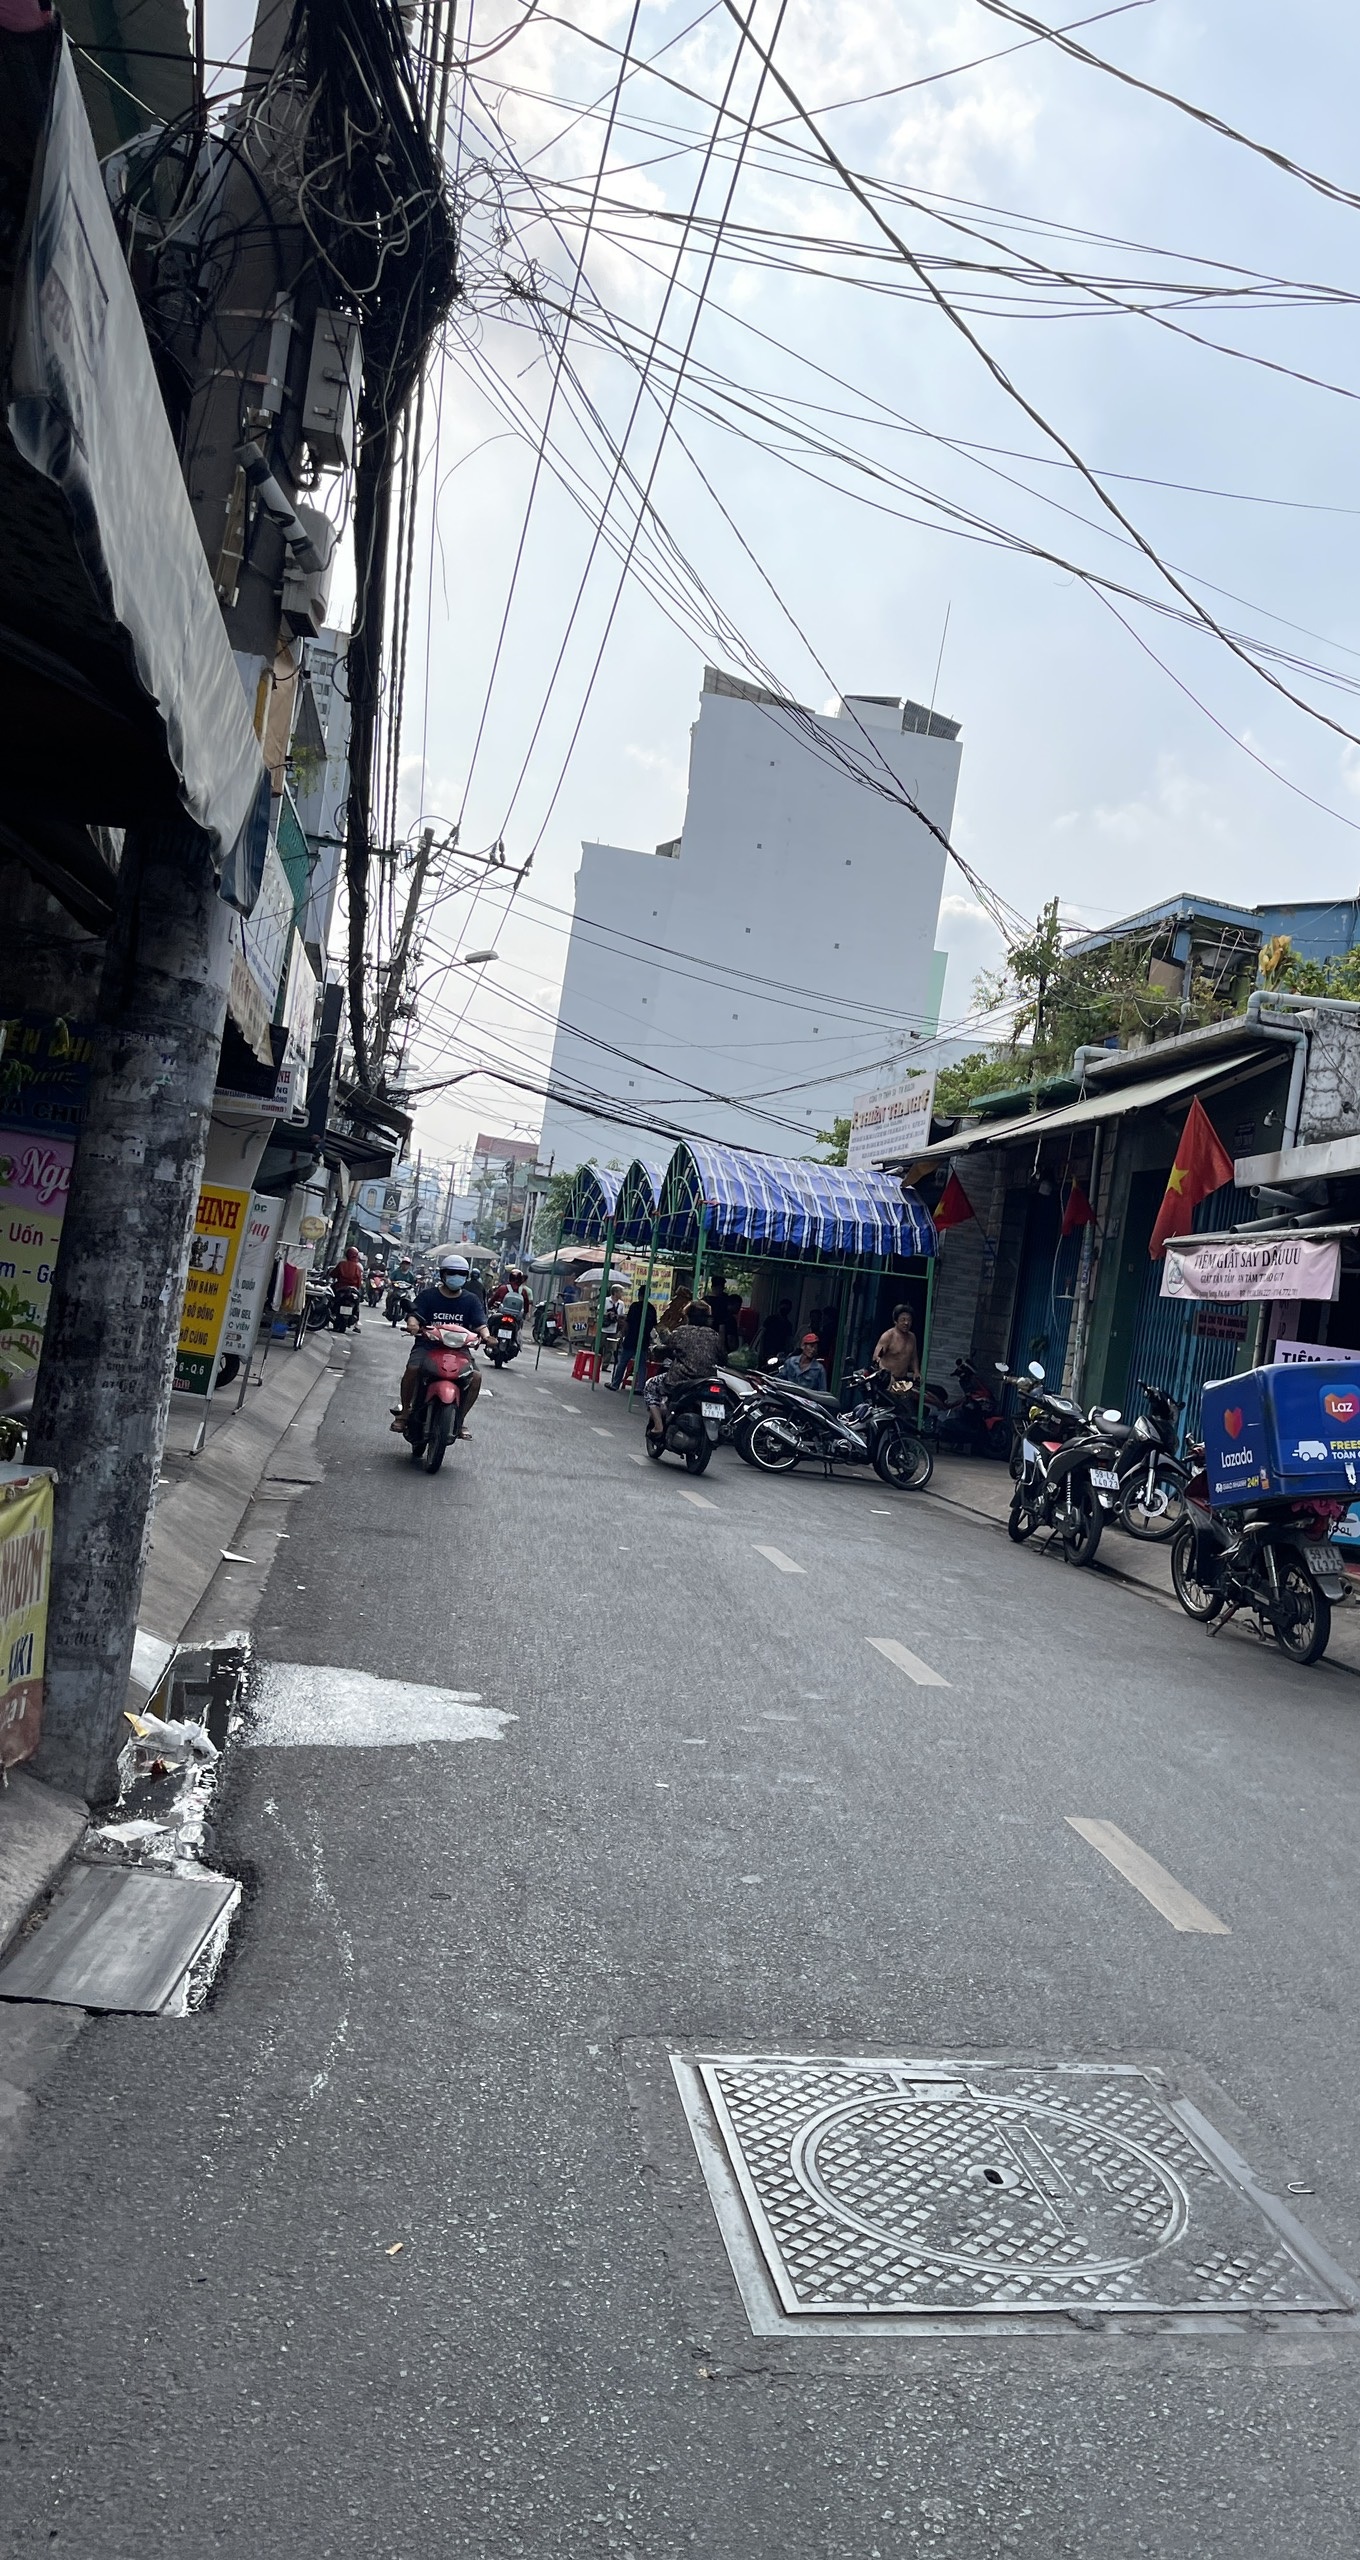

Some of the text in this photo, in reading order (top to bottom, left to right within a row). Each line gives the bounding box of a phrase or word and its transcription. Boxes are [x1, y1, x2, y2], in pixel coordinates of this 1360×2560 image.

[9, 1221, 44, 1247] Uốn
[433, 1312, 464, 1322] SCIENCE
[1331, 1401, 1354, 1413] Laz
[1221, 1446, 1253, 1468] Lazada
[1331, 1449, 1357, 1460] TOÀN
[1247, 1476, 1260, 1489] 24H
